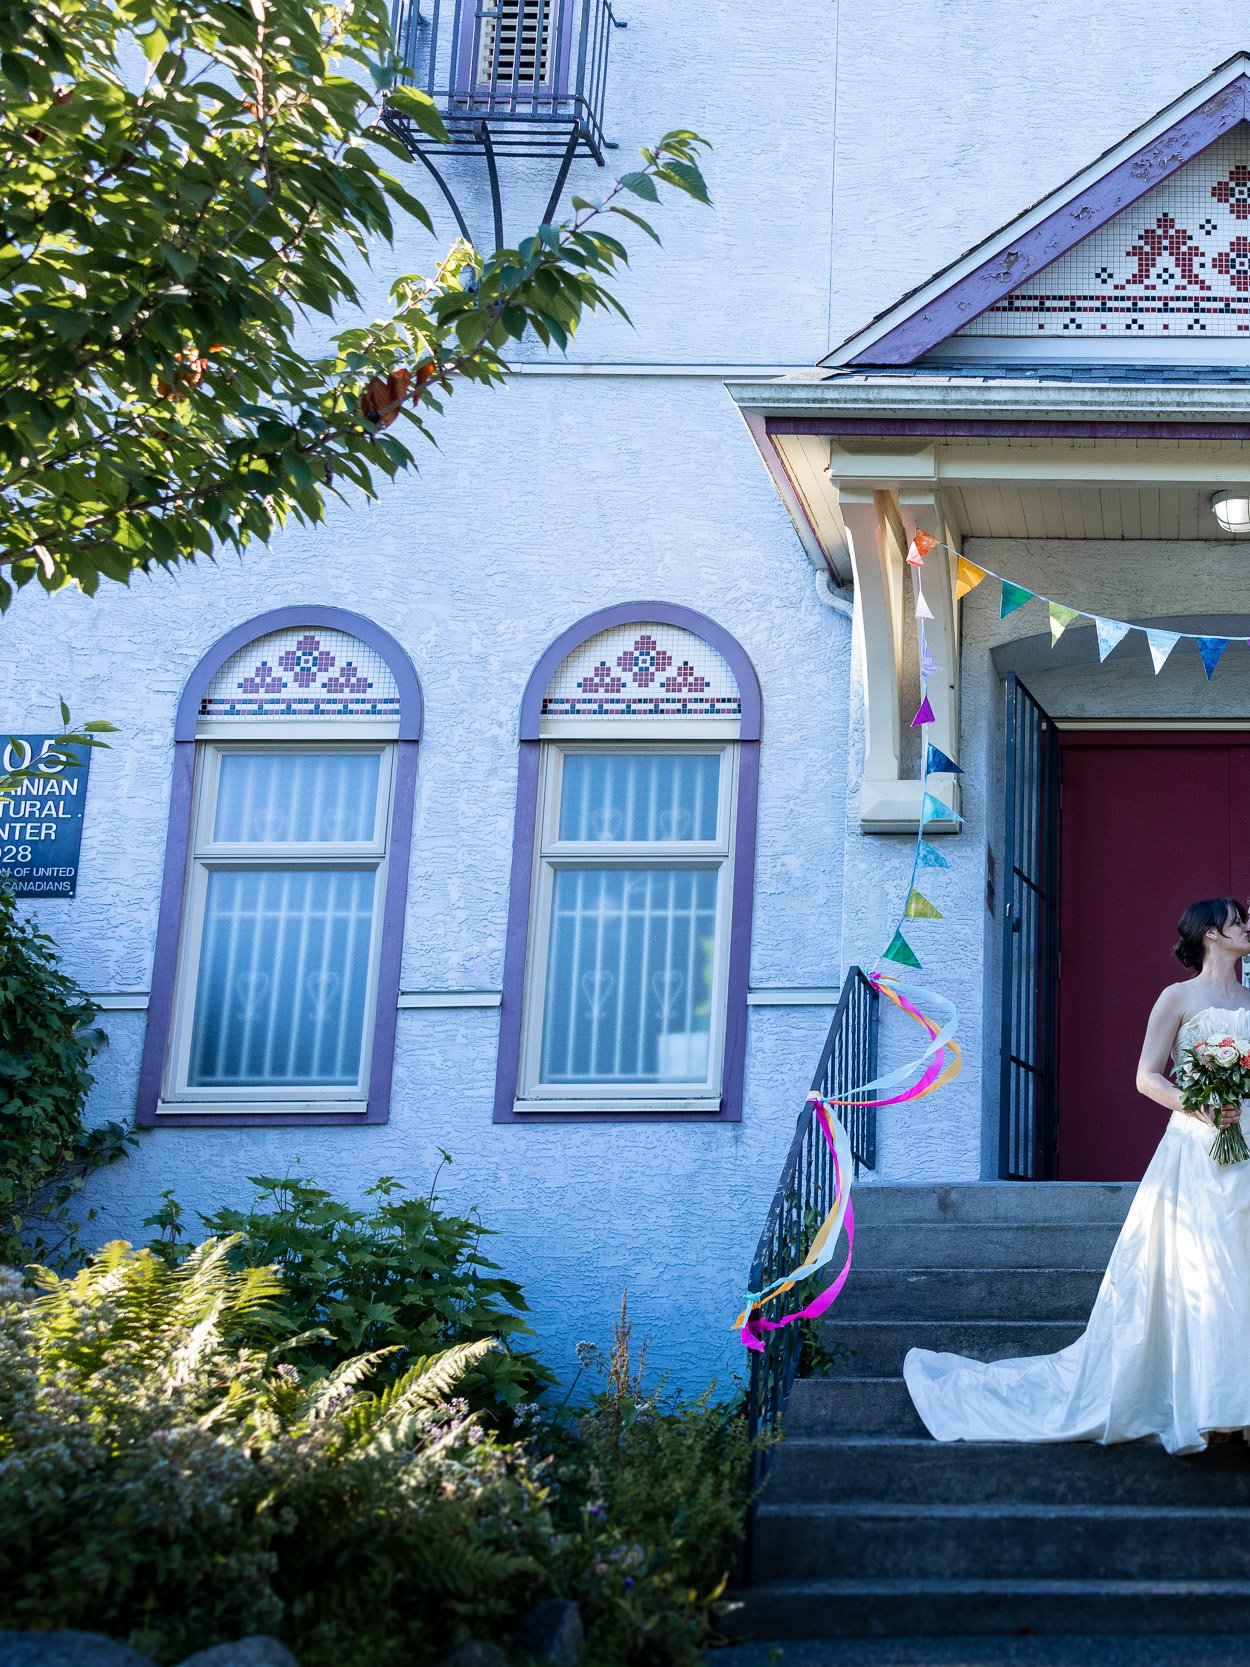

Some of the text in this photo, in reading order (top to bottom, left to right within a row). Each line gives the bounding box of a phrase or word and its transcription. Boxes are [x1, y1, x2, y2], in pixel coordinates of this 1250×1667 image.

[0, 778, 78, 796] NIAN
[0, 845, 32, 862] 28
[14, 867, 30, 877] OF
[33, 867, 75, 877] UNITED
